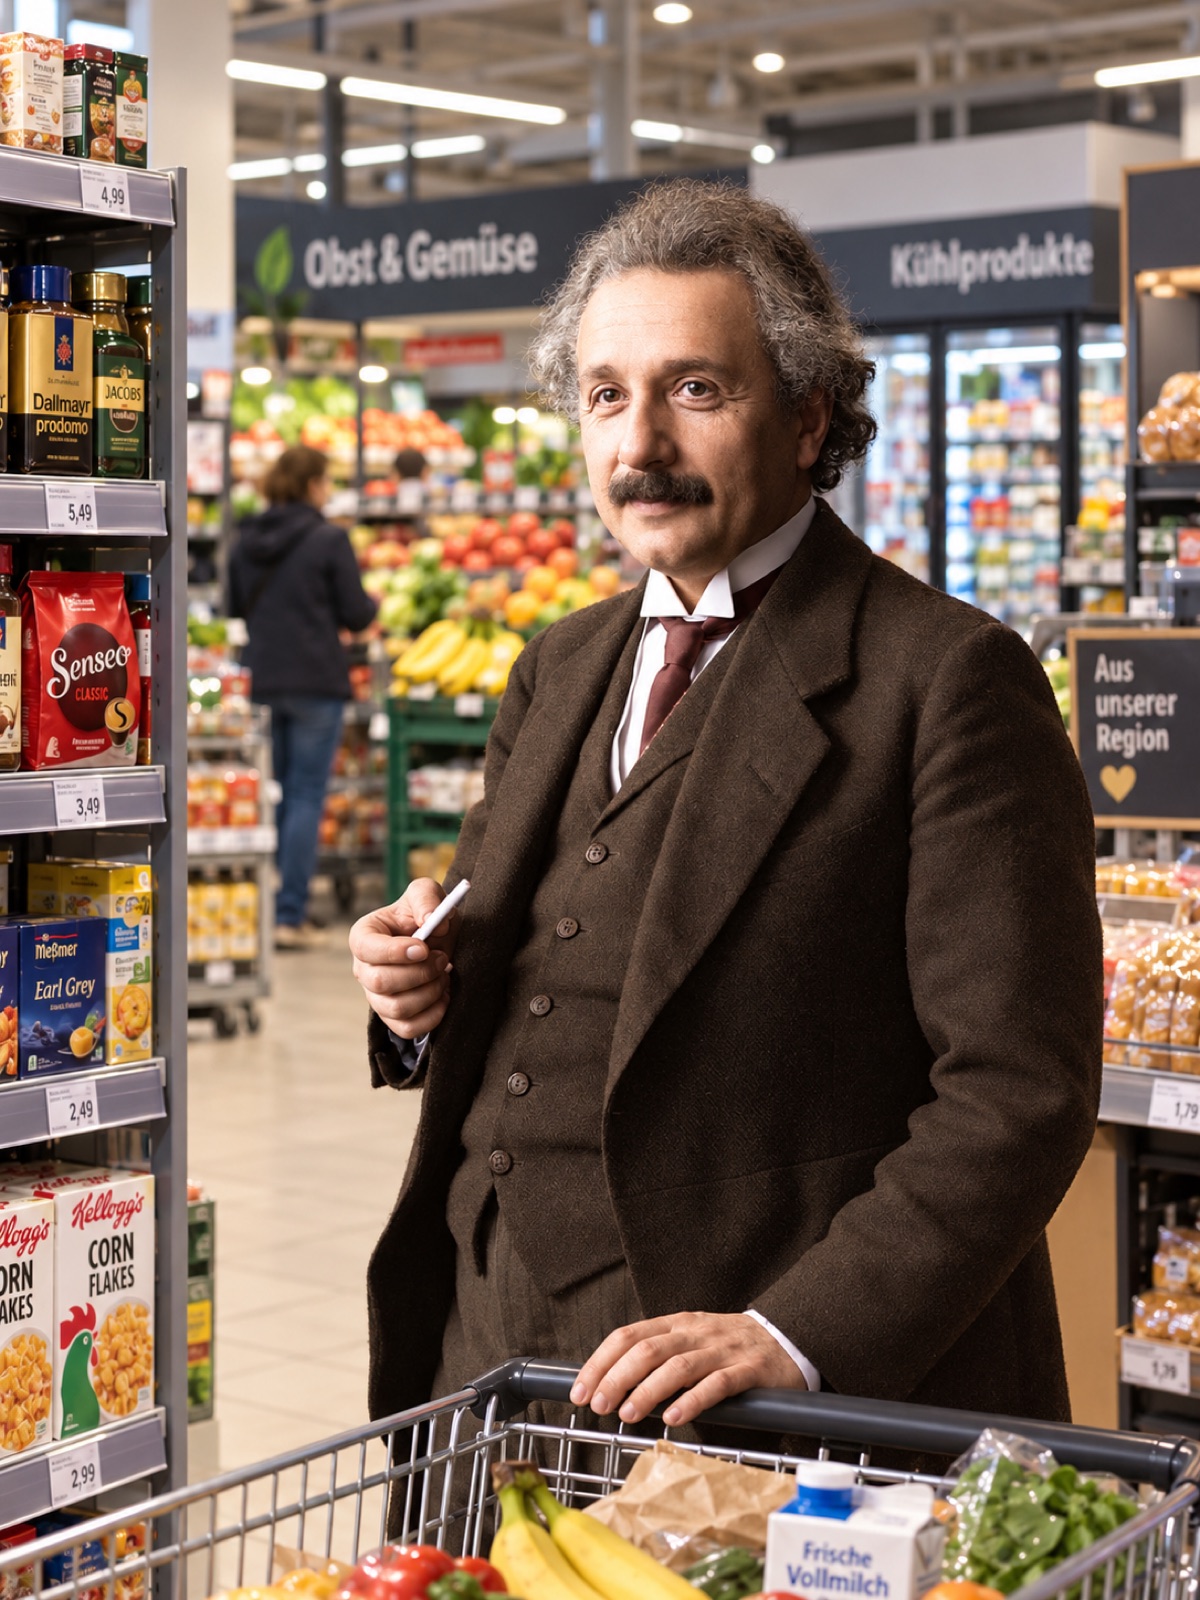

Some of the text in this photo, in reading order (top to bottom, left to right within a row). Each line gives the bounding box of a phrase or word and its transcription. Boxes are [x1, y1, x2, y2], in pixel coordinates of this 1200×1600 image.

[101, 186, 125, 208] 4,99
[304, 222, 538, 289] Obst & Gemüse
[891, 231, 1094, 294] Kühlprodukte
[33, 393, 91, 417] Dallmayr
[105, 384, 141, 401] JACOBS
[36, 416, 89, 436] prodomo
[69, 503, 92, 525] 5,49
[47, 645, 131, 699] Senseo
[1095, 653, 1135, 684] Aus
[75, 686, 109, 701] CLASSIC
[1095, 693, 1178, 719] unserer
[1096, 723, 1170, 758] Region
[76, 797, 100, 821] 3,49
[35, 942, 78, 962] Meßmer
[34, 977, 96, 1000] Earl Grey
[69, 1100, 93, 1126] 2,49
[1175, 1101, 1199, 1125] 1,79
[71, 1189, 145, 1231] Kellogg's
[88, 1232, 134, 1270] CORN
[89, 1264, 135, 1298] FLAKES
[71, 1463, 95, 1491] 2,99
[803, 1541, 872, 1568] Frische
[787, 1564, 889, 1597] Vollmilch
